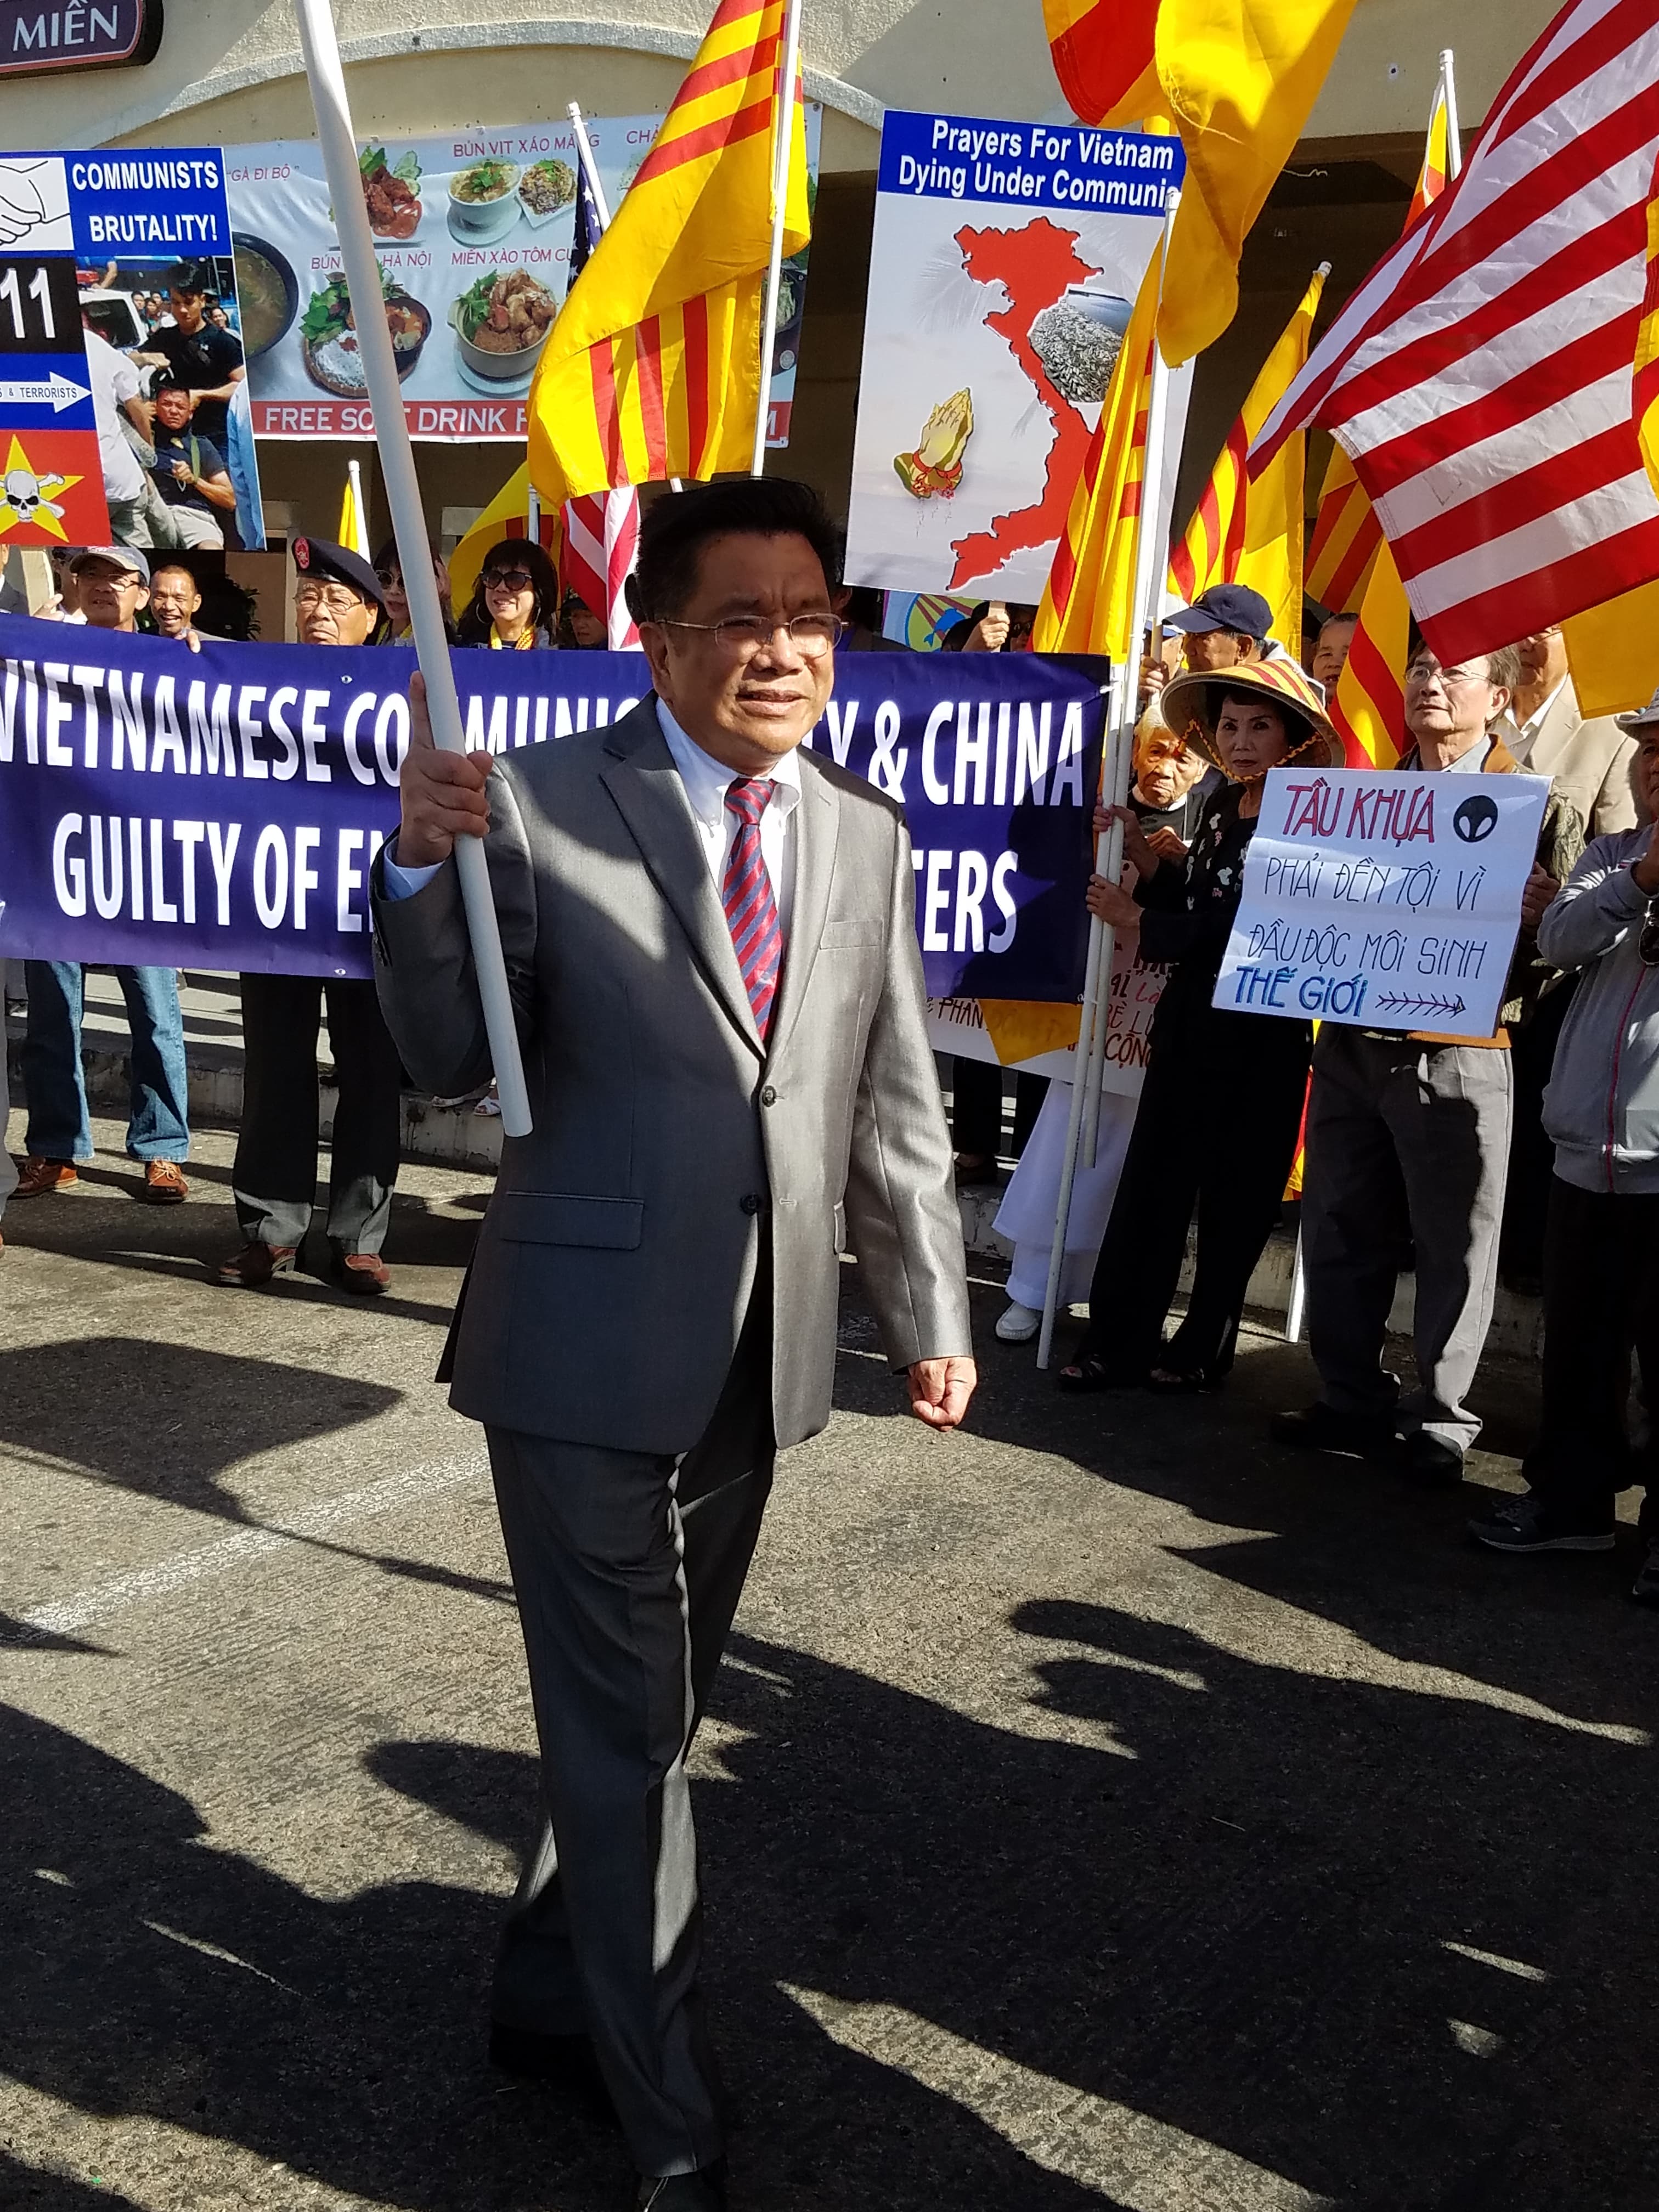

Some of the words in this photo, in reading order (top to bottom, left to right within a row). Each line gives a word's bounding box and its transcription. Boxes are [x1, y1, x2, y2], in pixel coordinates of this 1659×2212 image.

[453, 140, 486, 157] BÚN
[554, 133, 600, 150] MĂG
[932, 119, 1022, 158] Prayers
[1030, 128, 1071, 162] For
[1079, 132, 1174, 170] Vietnam
[72, 161, 219, 191] COMMUNISTS
[898, 154, 967, 198] Dying
[974, 162, 1046, 198] Under
[1052, 169, 1179, 208] Communi
[90, 213, 218, 242] BRUTALITY!
[311, 254, 341, 269] BÚN
[521, 246, 552, 263] TÔM
[19, 387, 77, 398] TERRORISTS
[265, 407, 334, 431] FREE
[418, 407, 507, 432] DRINK
[0, 658, 331, 782] VIETNAMESE
[867, 699, 909, 805] &
[922, 701, 1084, 807] CHINA
[53, 812, 242, 927] GUILTY
[253, 823, 321, 930] OF
